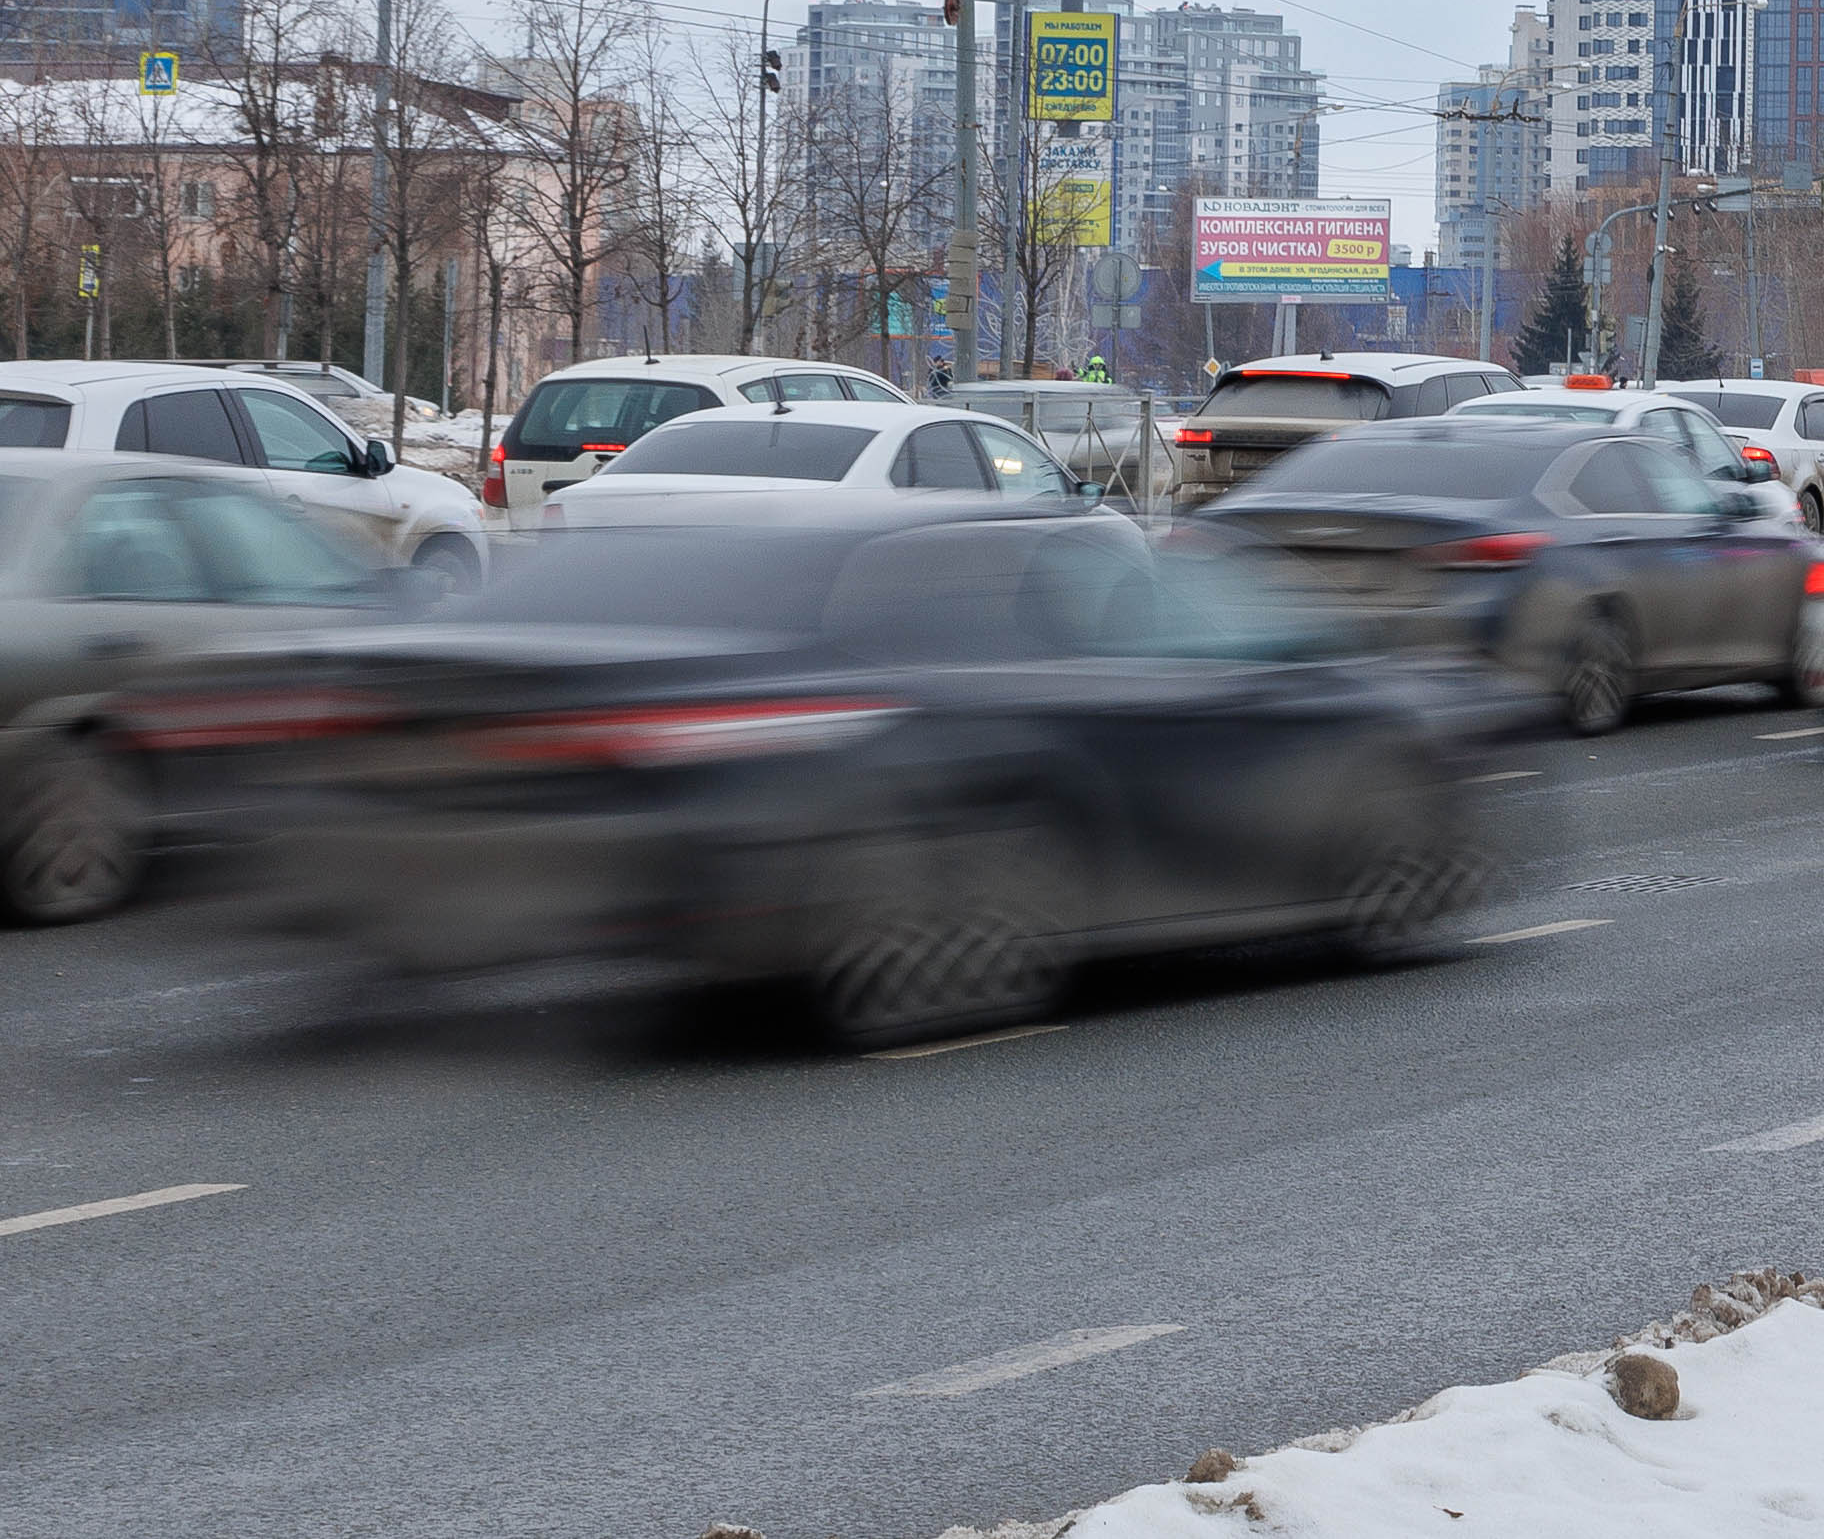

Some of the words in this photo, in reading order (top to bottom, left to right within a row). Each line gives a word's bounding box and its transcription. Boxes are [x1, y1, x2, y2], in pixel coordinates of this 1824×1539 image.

[1044, 21, 1059, 30] МЫ
[1060, 22, 1103, 31] РАБОТАЕМ
[1041, 43, 1105, 66] 07:00
[1040, 68, 1104, 92] 23:00
[1223, 201, 1301, 213] НОВАДЭНТ
[1200, 219, 1314, 235] КОМПЛЕКСНАЯ
[1317, 221, 1385, 236] ГИГИЕНА
[1200, 240, 1249, 256] ЗУБОВ
[1251, 240, 1323, 258] (ЧИСТКА)
[1333, 243, 1364, 255] 3500
